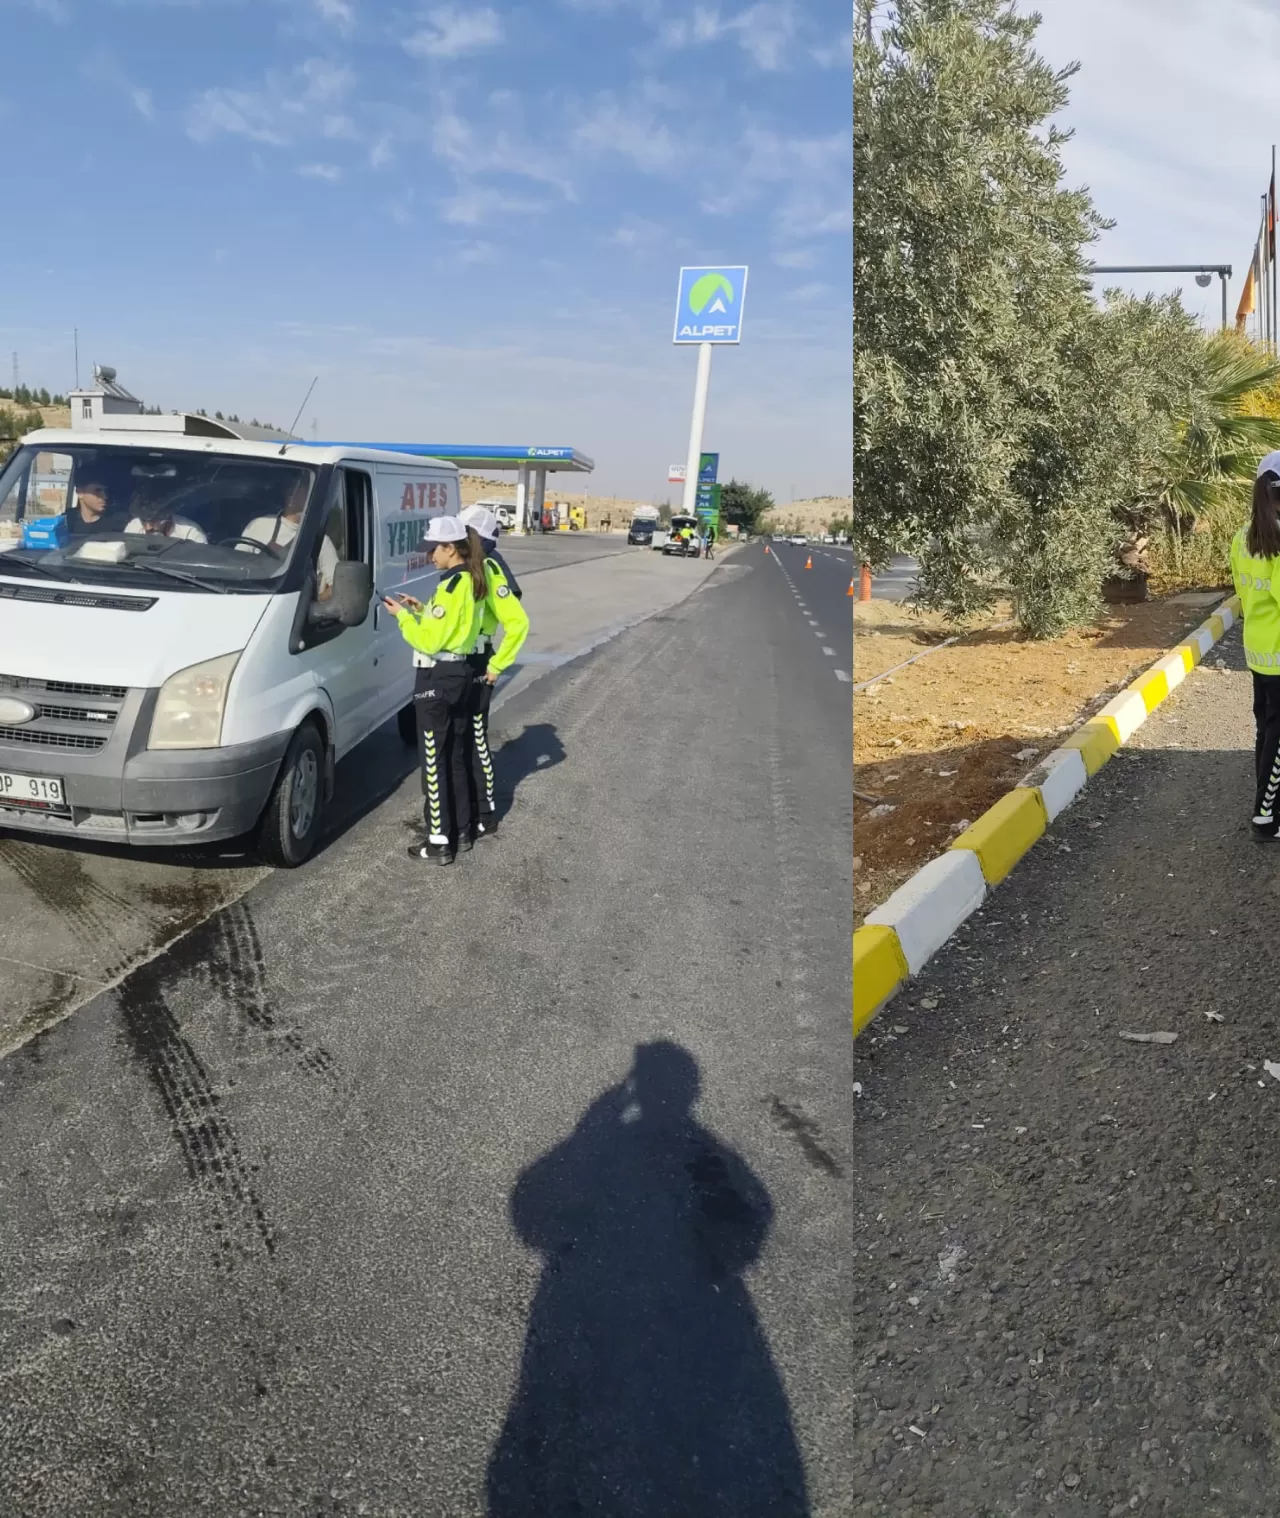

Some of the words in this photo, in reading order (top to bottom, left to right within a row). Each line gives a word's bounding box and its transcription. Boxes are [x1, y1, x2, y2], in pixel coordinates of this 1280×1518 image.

[679, 325, 737, 336] ALPET
[401, 482, 448, 514] ATEŞ
[29, 779, 60, 799] 919
